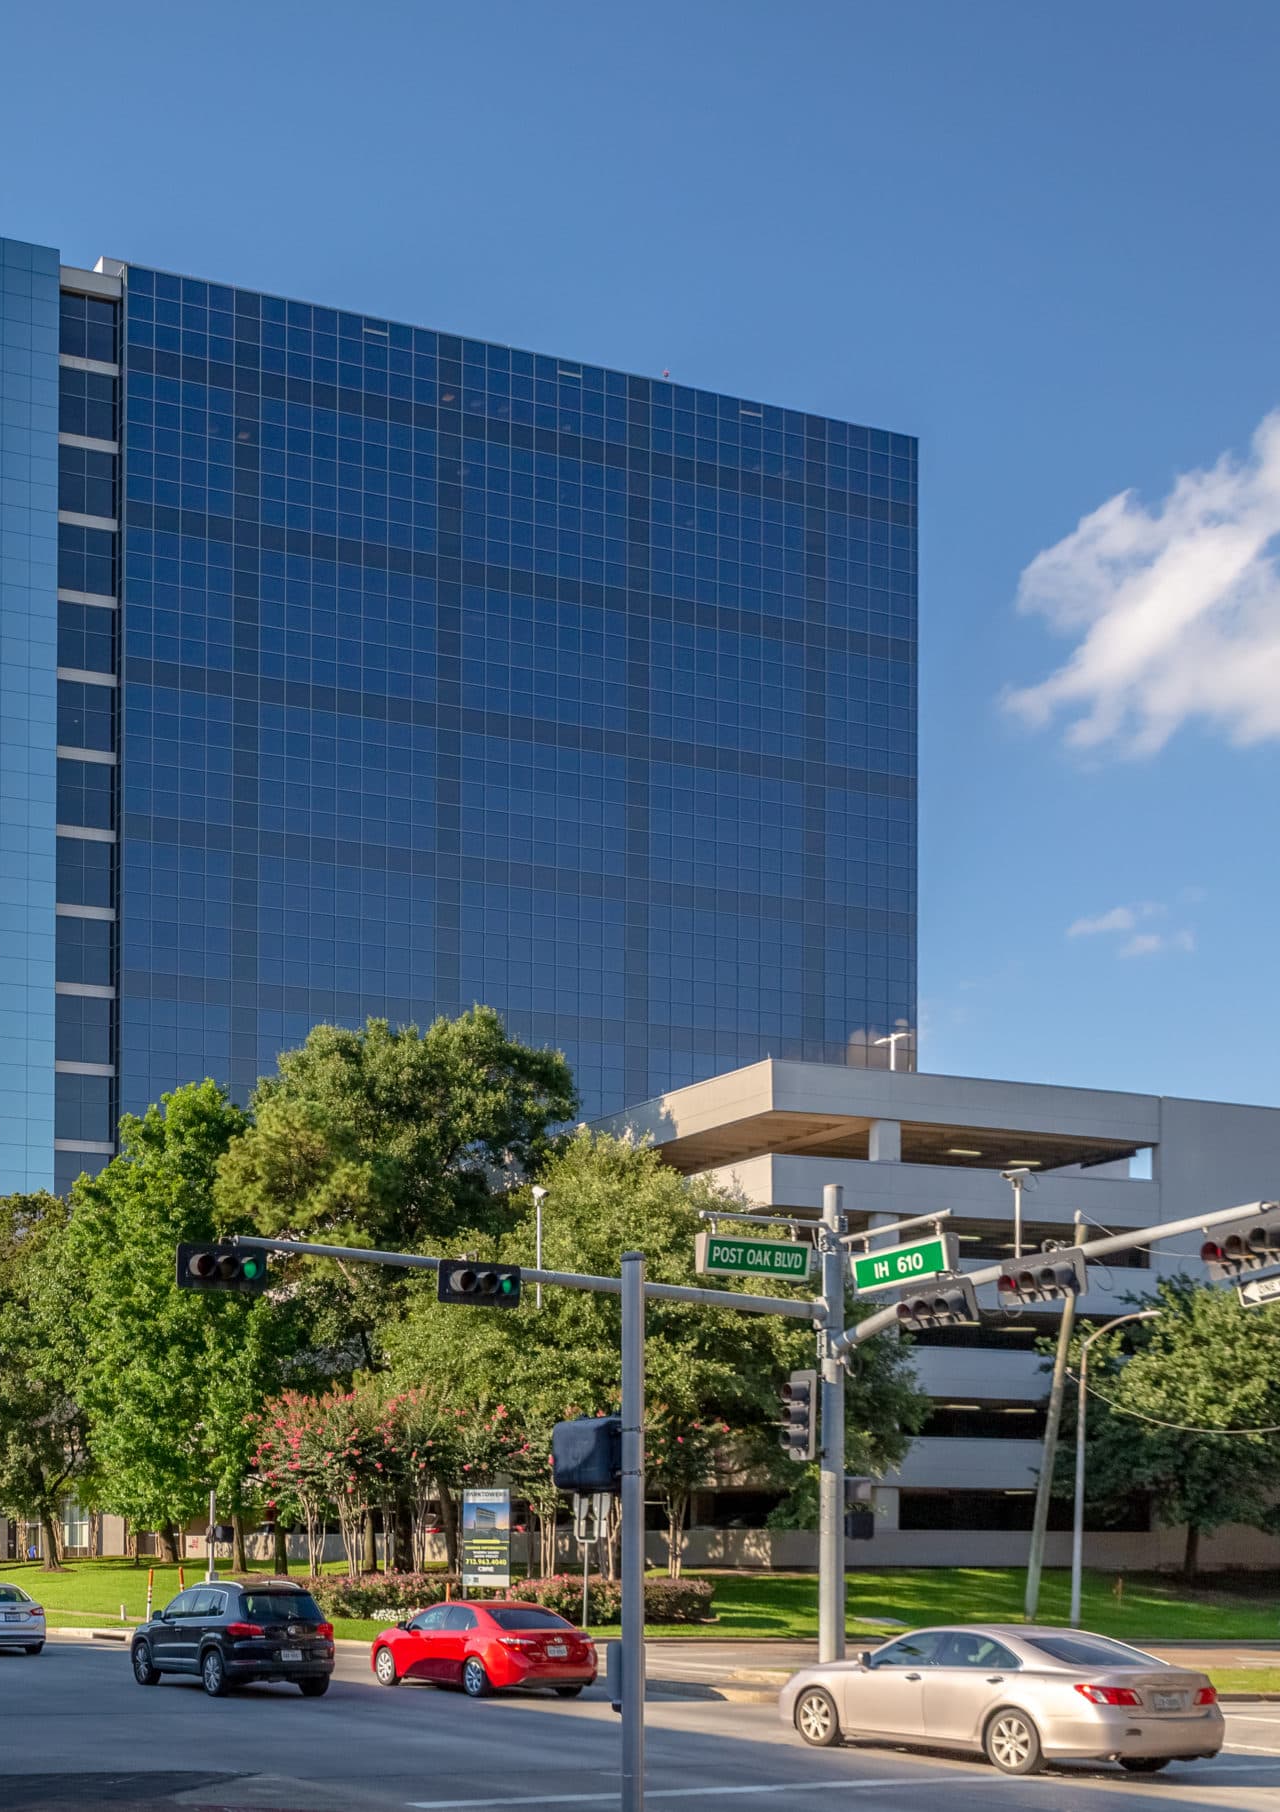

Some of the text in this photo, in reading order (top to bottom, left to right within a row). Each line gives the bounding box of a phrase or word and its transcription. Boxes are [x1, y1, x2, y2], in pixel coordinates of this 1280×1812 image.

[712, 1246, 803, 1270] POST OAK BLVD
[874, 1253, 924, 1279] IH 610
